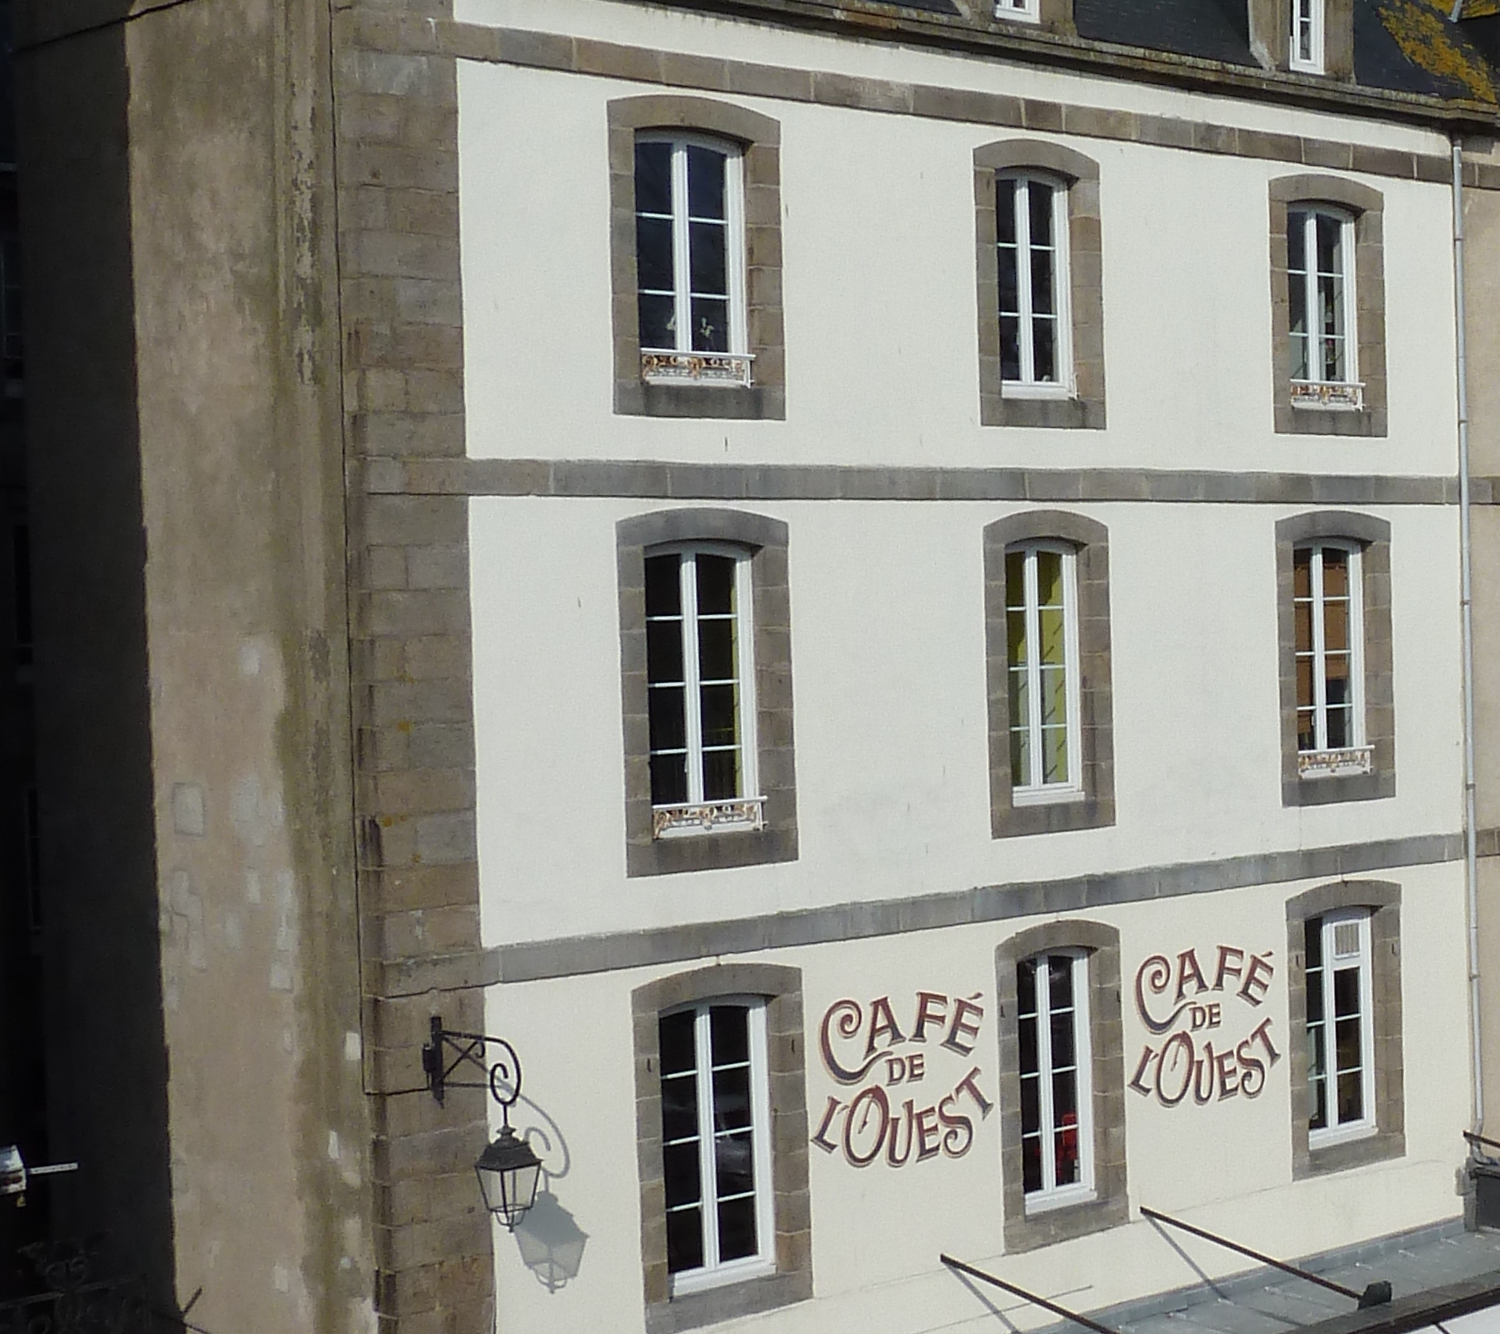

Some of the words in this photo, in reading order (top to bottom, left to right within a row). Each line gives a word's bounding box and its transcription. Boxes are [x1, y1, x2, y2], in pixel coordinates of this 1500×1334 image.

[1134, 945, 1275, 1035] CAFÉ
[1190, 1002, 1221, 1032] DE
[820, 992, 985, 1085] CAFÉ
[886, 1053, 924, 1086] DE
[1128, 1017, 1282, 1108] L'OUEST
[811, 1066, 994, 1168] L'OUEST
